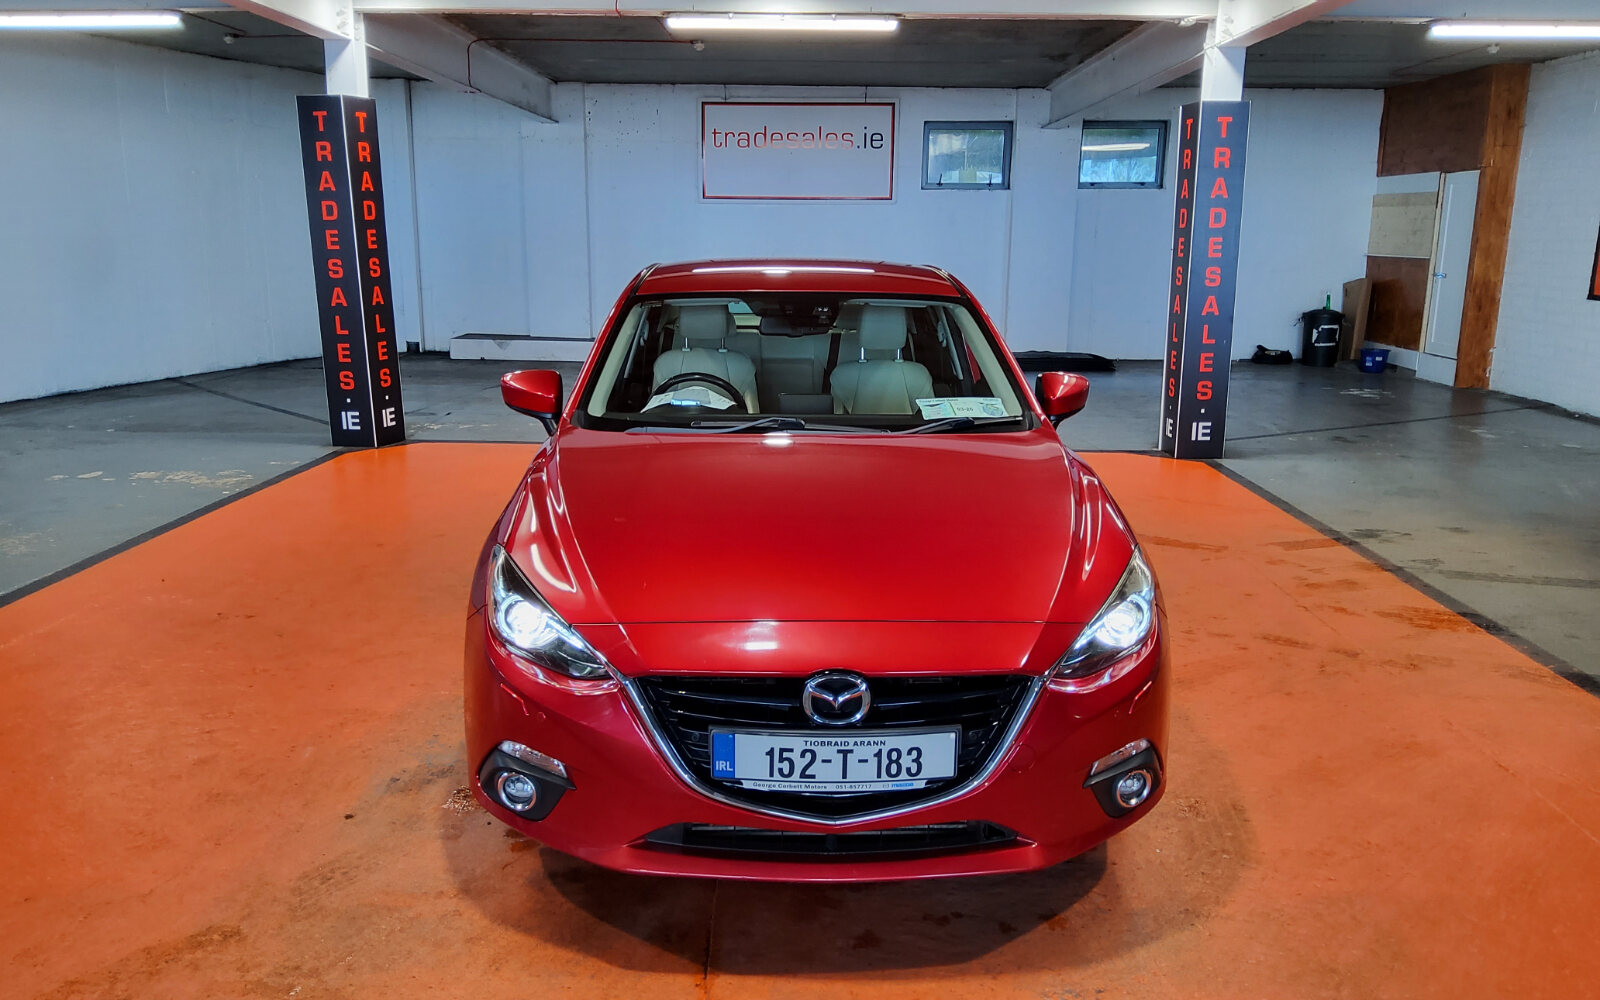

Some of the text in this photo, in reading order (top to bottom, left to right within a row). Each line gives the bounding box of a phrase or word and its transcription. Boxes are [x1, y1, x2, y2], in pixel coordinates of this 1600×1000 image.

[711, 125, 884, 150] tradesales.ie
[803, 740, 850, 748] TIOBRAID
[715, 760, 734, 772] IRL
[765, 746, 923, 780] 152-T-183
[752, 781, 777, 790] George
